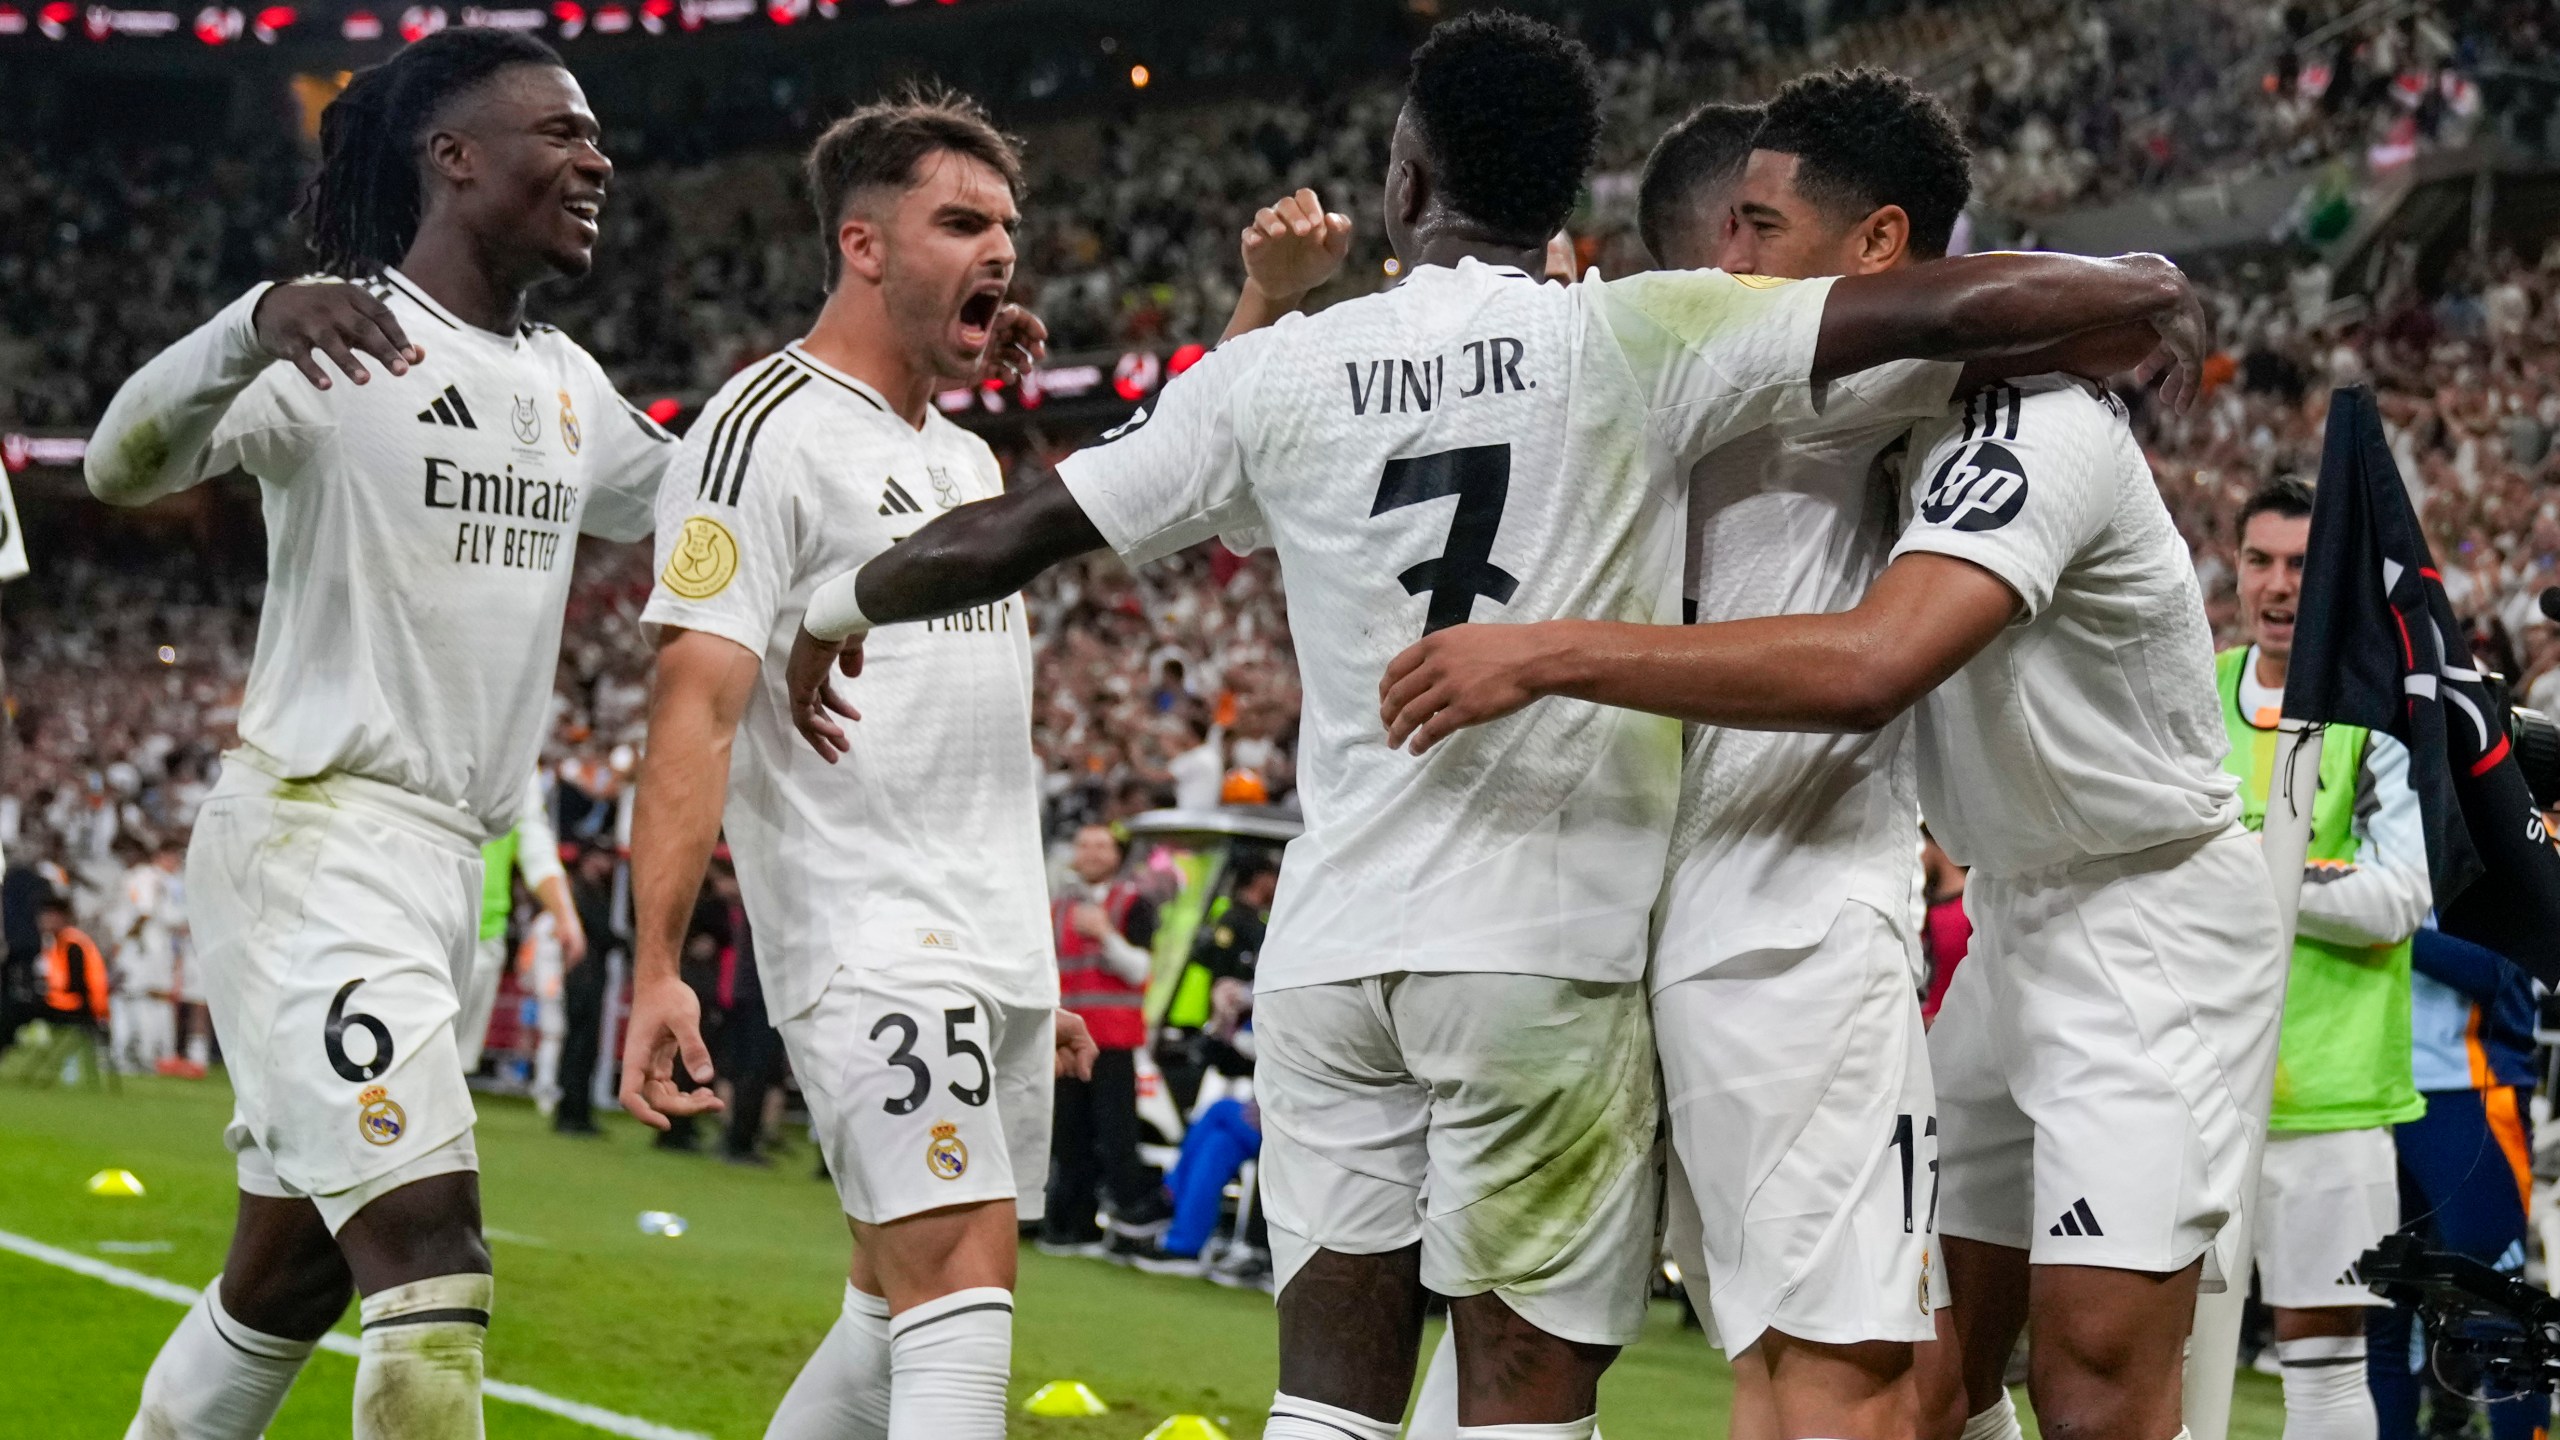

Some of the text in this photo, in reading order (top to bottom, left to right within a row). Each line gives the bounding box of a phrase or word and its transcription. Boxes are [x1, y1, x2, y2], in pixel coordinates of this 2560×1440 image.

[1345, 337, 1537, 416] VINI JR.
[424, 457, 578, 523] Emirates
[1921, 441, 2029, 532] hp
[456, 522, 560, 571] FLY BETTER
[1369, 442, 1520, 639] 7
[324, 977, 394, 1083] 6
[868, 1004, 991, 1116] 35
